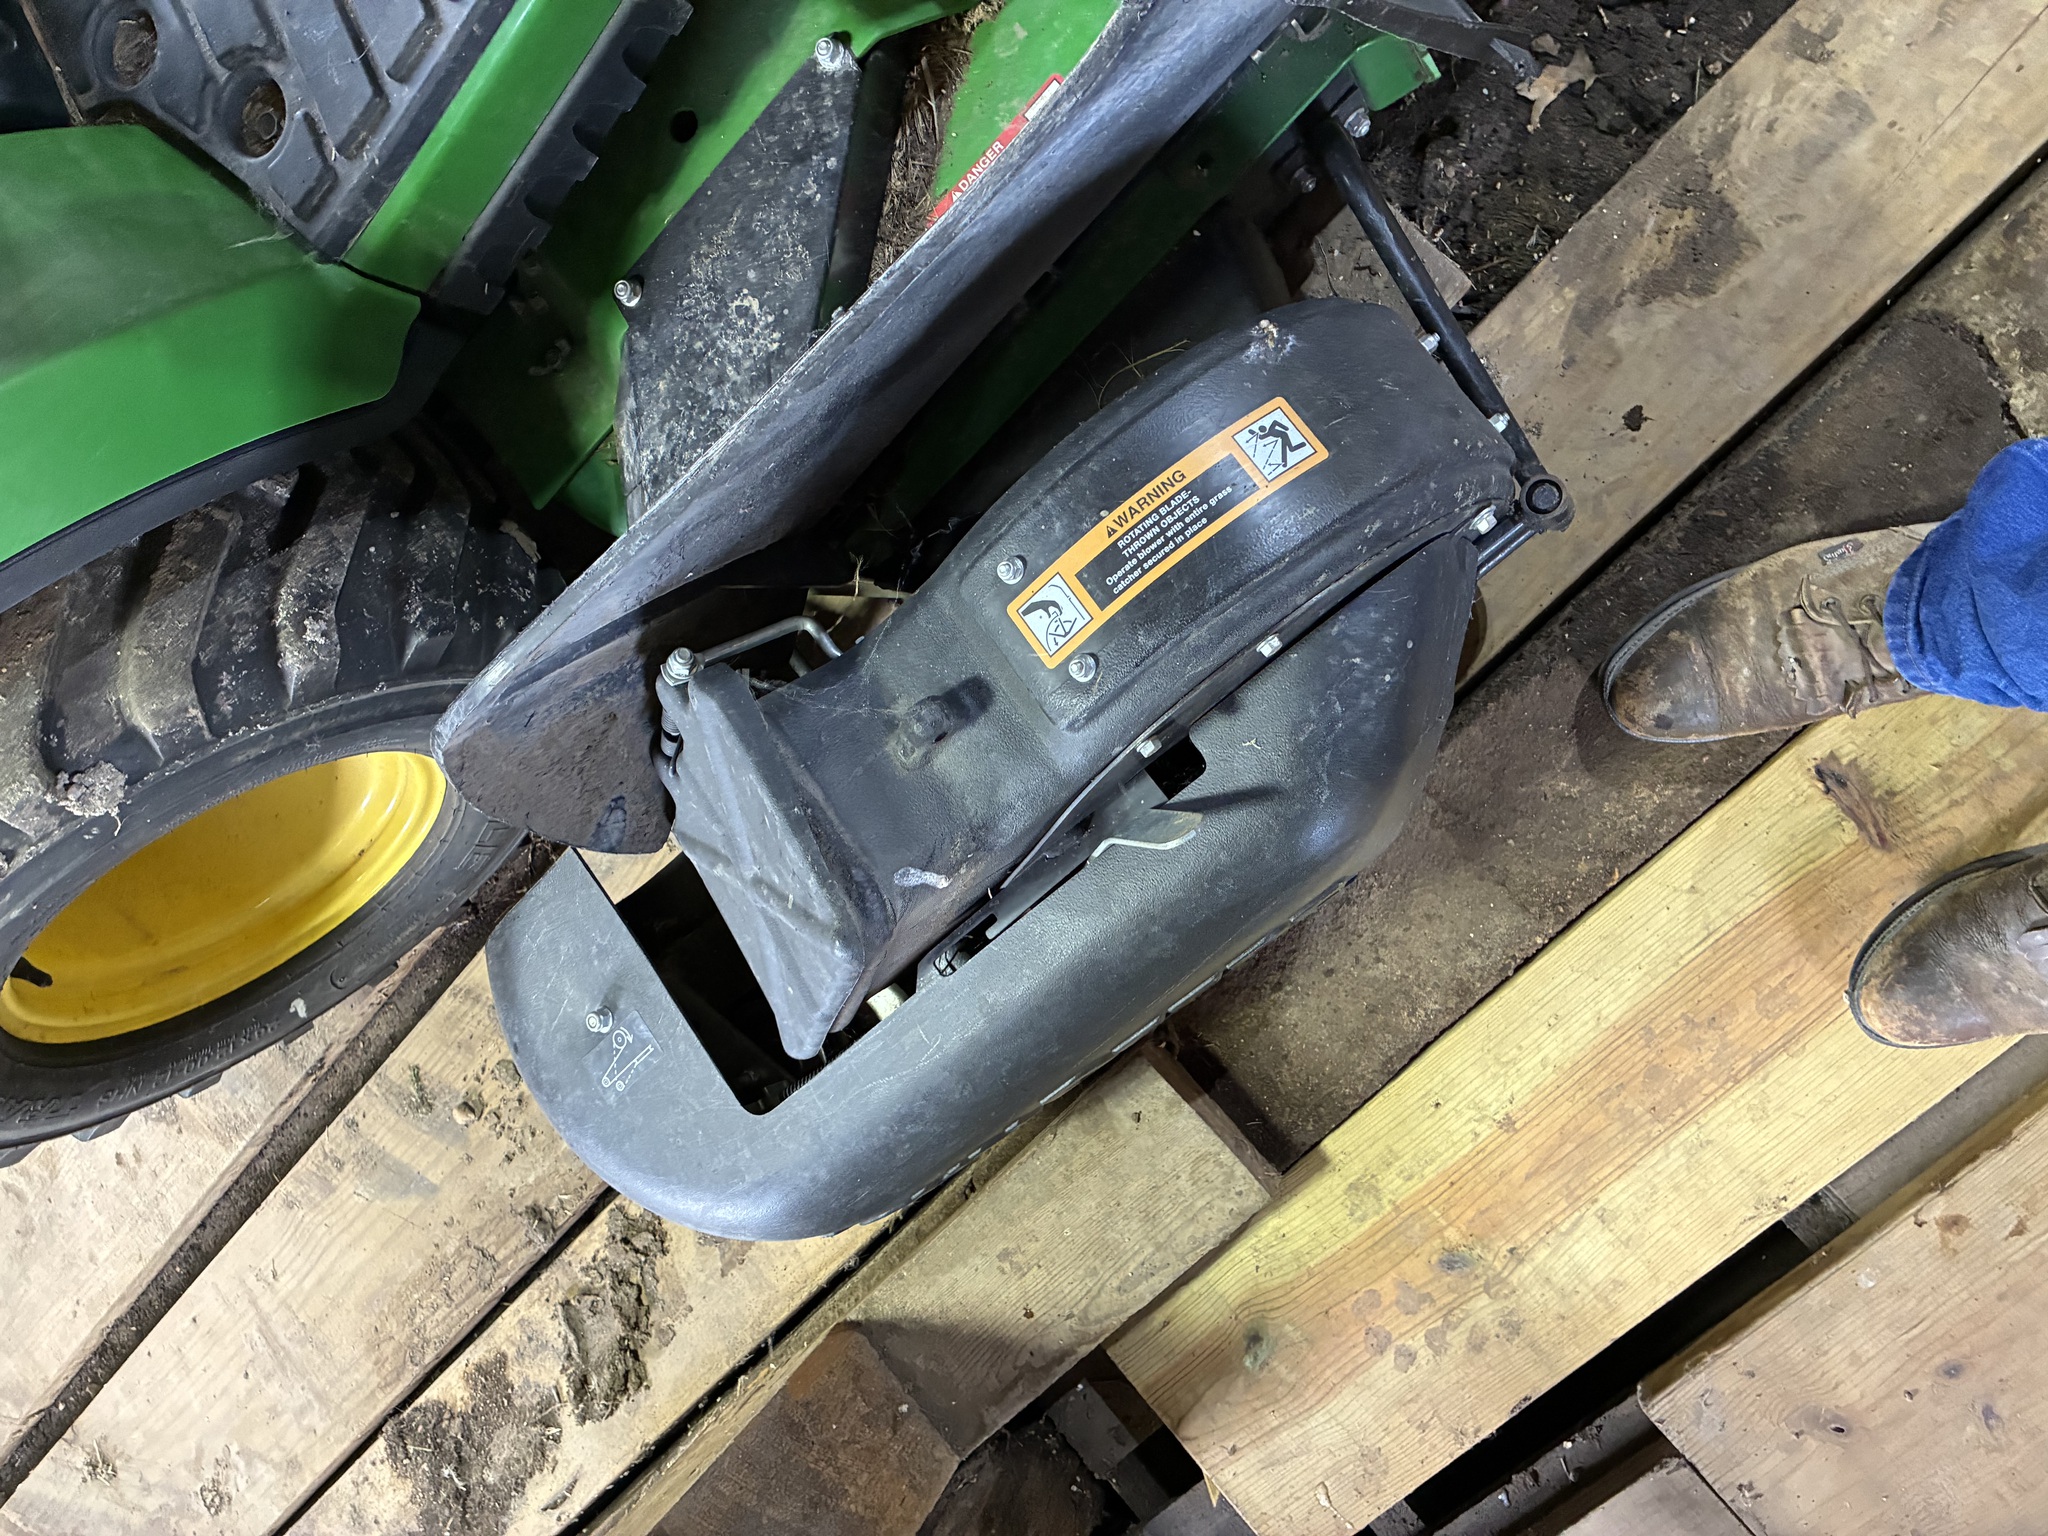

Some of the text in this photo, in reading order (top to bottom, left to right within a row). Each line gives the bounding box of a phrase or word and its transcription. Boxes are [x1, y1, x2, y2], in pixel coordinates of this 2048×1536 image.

[958, 141, 1004, 191] DANGER
[1113, 469, 1187, 528] WARNING
[1117, 489, 1192, 549] ROTATING BLADE-
[1122, 496, 1200, 558] THROWN OBJECTS
[1106, 486, 1232, 586] Operate blower with entire grass
[1113, 517, 1208, 594] catcher secured in place
